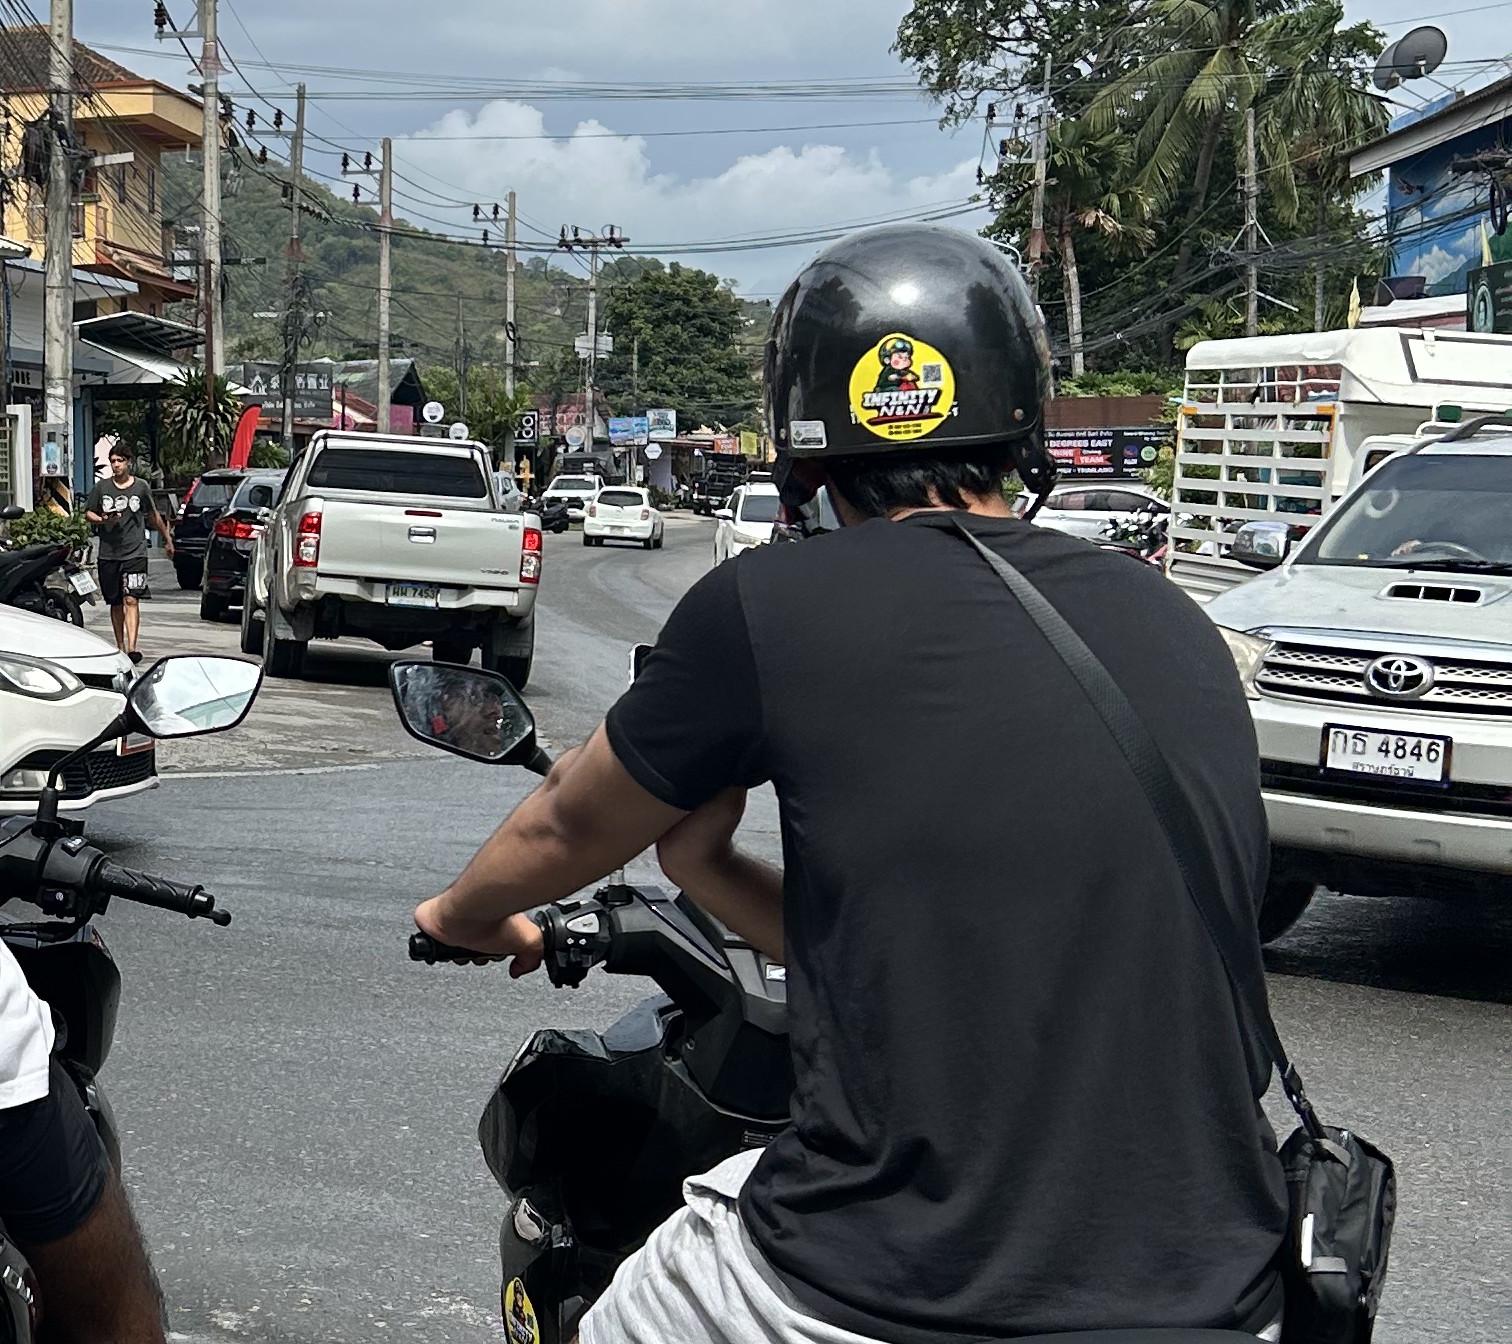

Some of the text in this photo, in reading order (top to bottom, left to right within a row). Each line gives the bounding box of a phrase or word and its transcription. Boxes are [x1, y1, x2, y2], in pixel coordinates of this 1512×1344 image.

[863, 388, 938, 407] INFINITY
[1090, 439, 1114, 448] EAST
[1377, 735, 1440, 764] 4846
